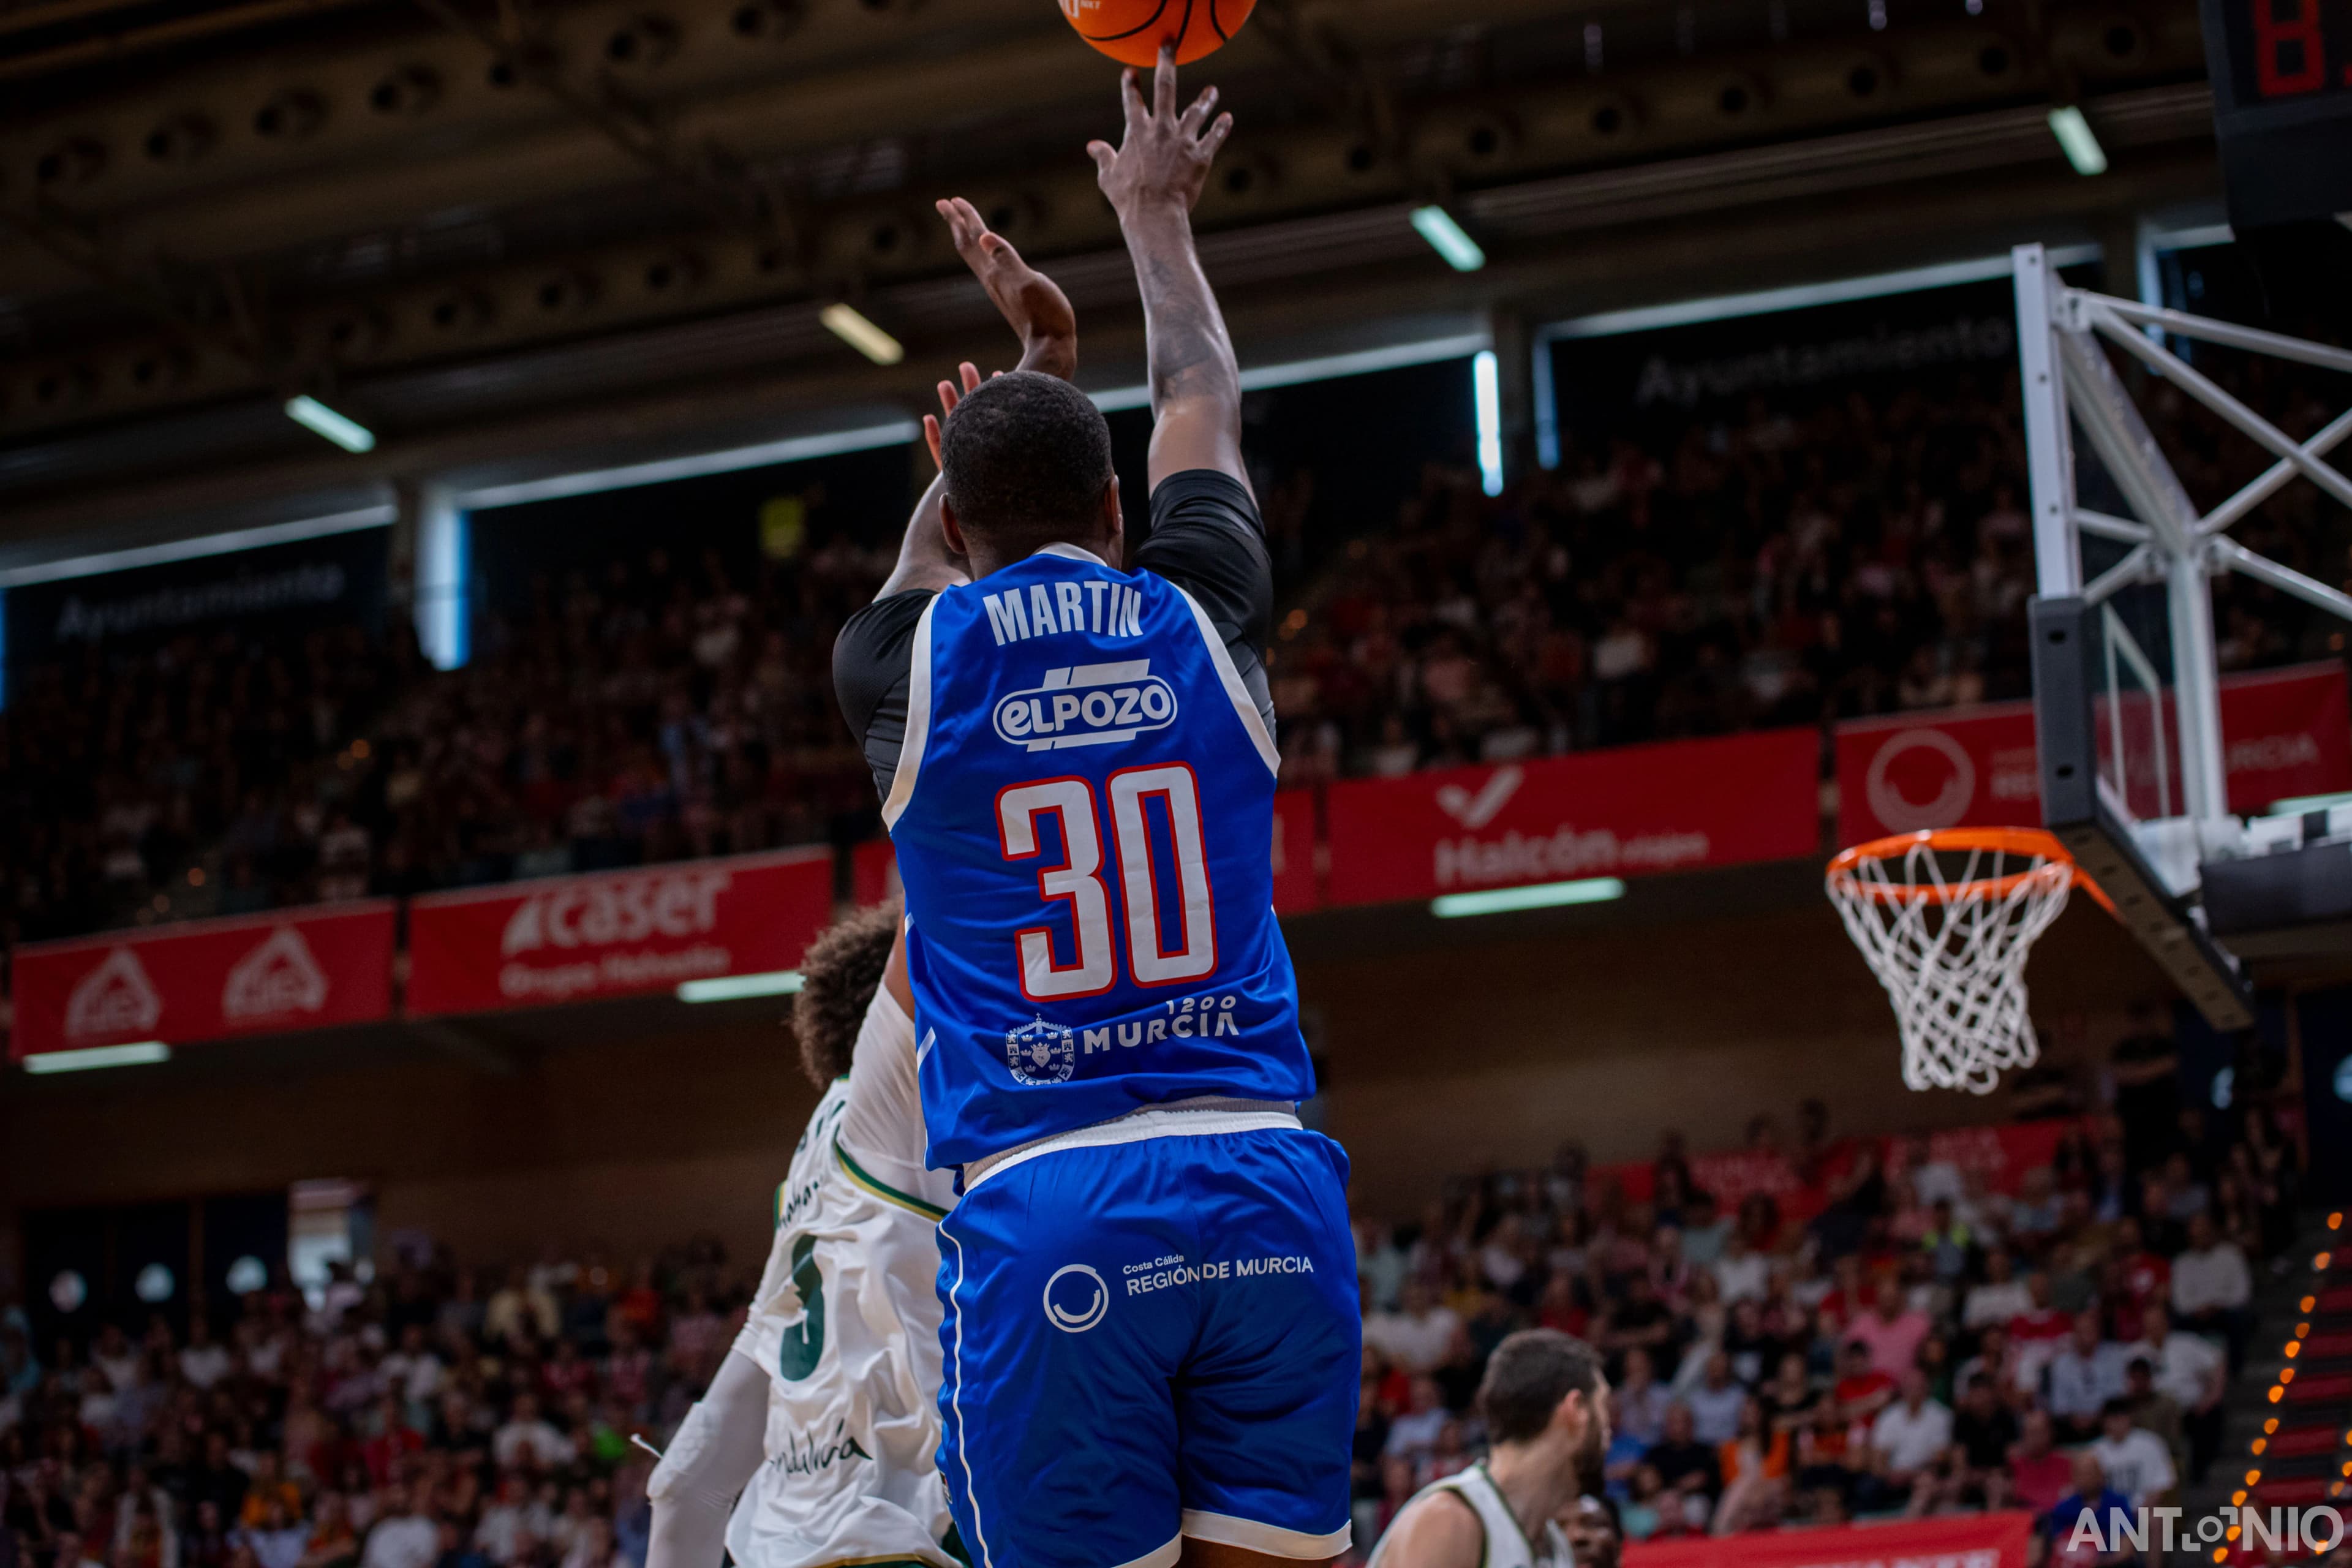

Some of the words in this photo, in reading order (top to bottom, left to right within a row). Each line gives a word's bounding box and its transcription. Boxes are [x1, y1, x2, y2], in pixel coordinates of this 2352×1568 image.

[982, 581, 1144, 647] MARTIN
[995, 760, 1219, 1002] 30
[1166, 995, 1237, 1016] 1200
[1083, 1011, 1240, 1055] MURCIA
[1122, 1261, 1153, 1275] Costa
[1154, 1253, 1185, 1268] Cálida
[1126, 1264, 1200, 1297] REGIÓN
[1202, 1261, 1231, 1280] DE
[1235, 1255, 1314, 1278] MURCIA
